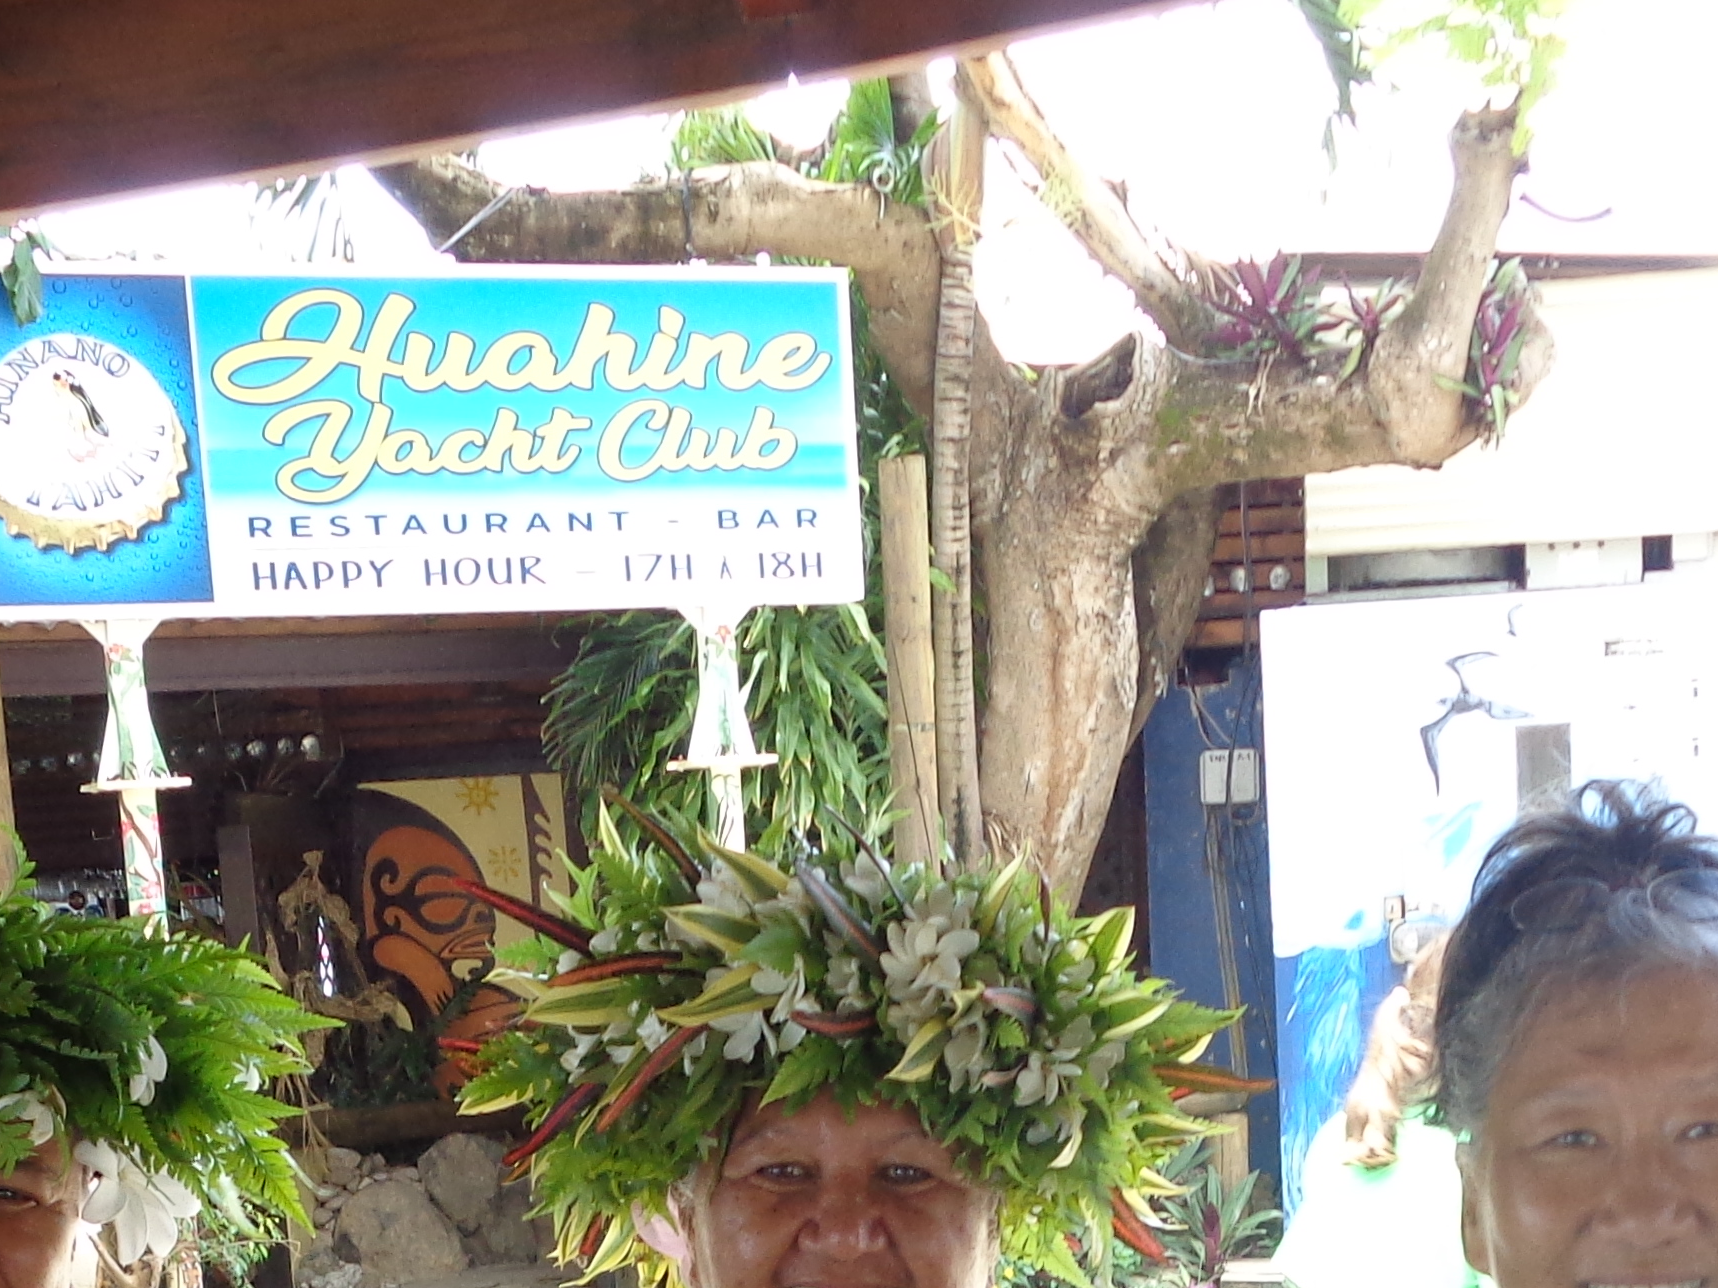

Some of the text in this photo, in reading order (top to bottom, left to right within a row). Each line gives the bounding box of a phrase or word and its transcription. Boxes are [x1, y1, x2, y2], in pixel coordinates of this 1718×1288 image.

[211, 287, 833, 406] Huahine
[262, 398, 798, 505] Yacht Club
[247, 511, 630, 538] RESTAURANT
[717, 508, 817, 529] BAR
[252, 558, 394, 590] HAPPY
[424, 556, 546, 586] HOUR
[625, 553, 693, 582] 17H
[758, 551, 822, 579] 18H
